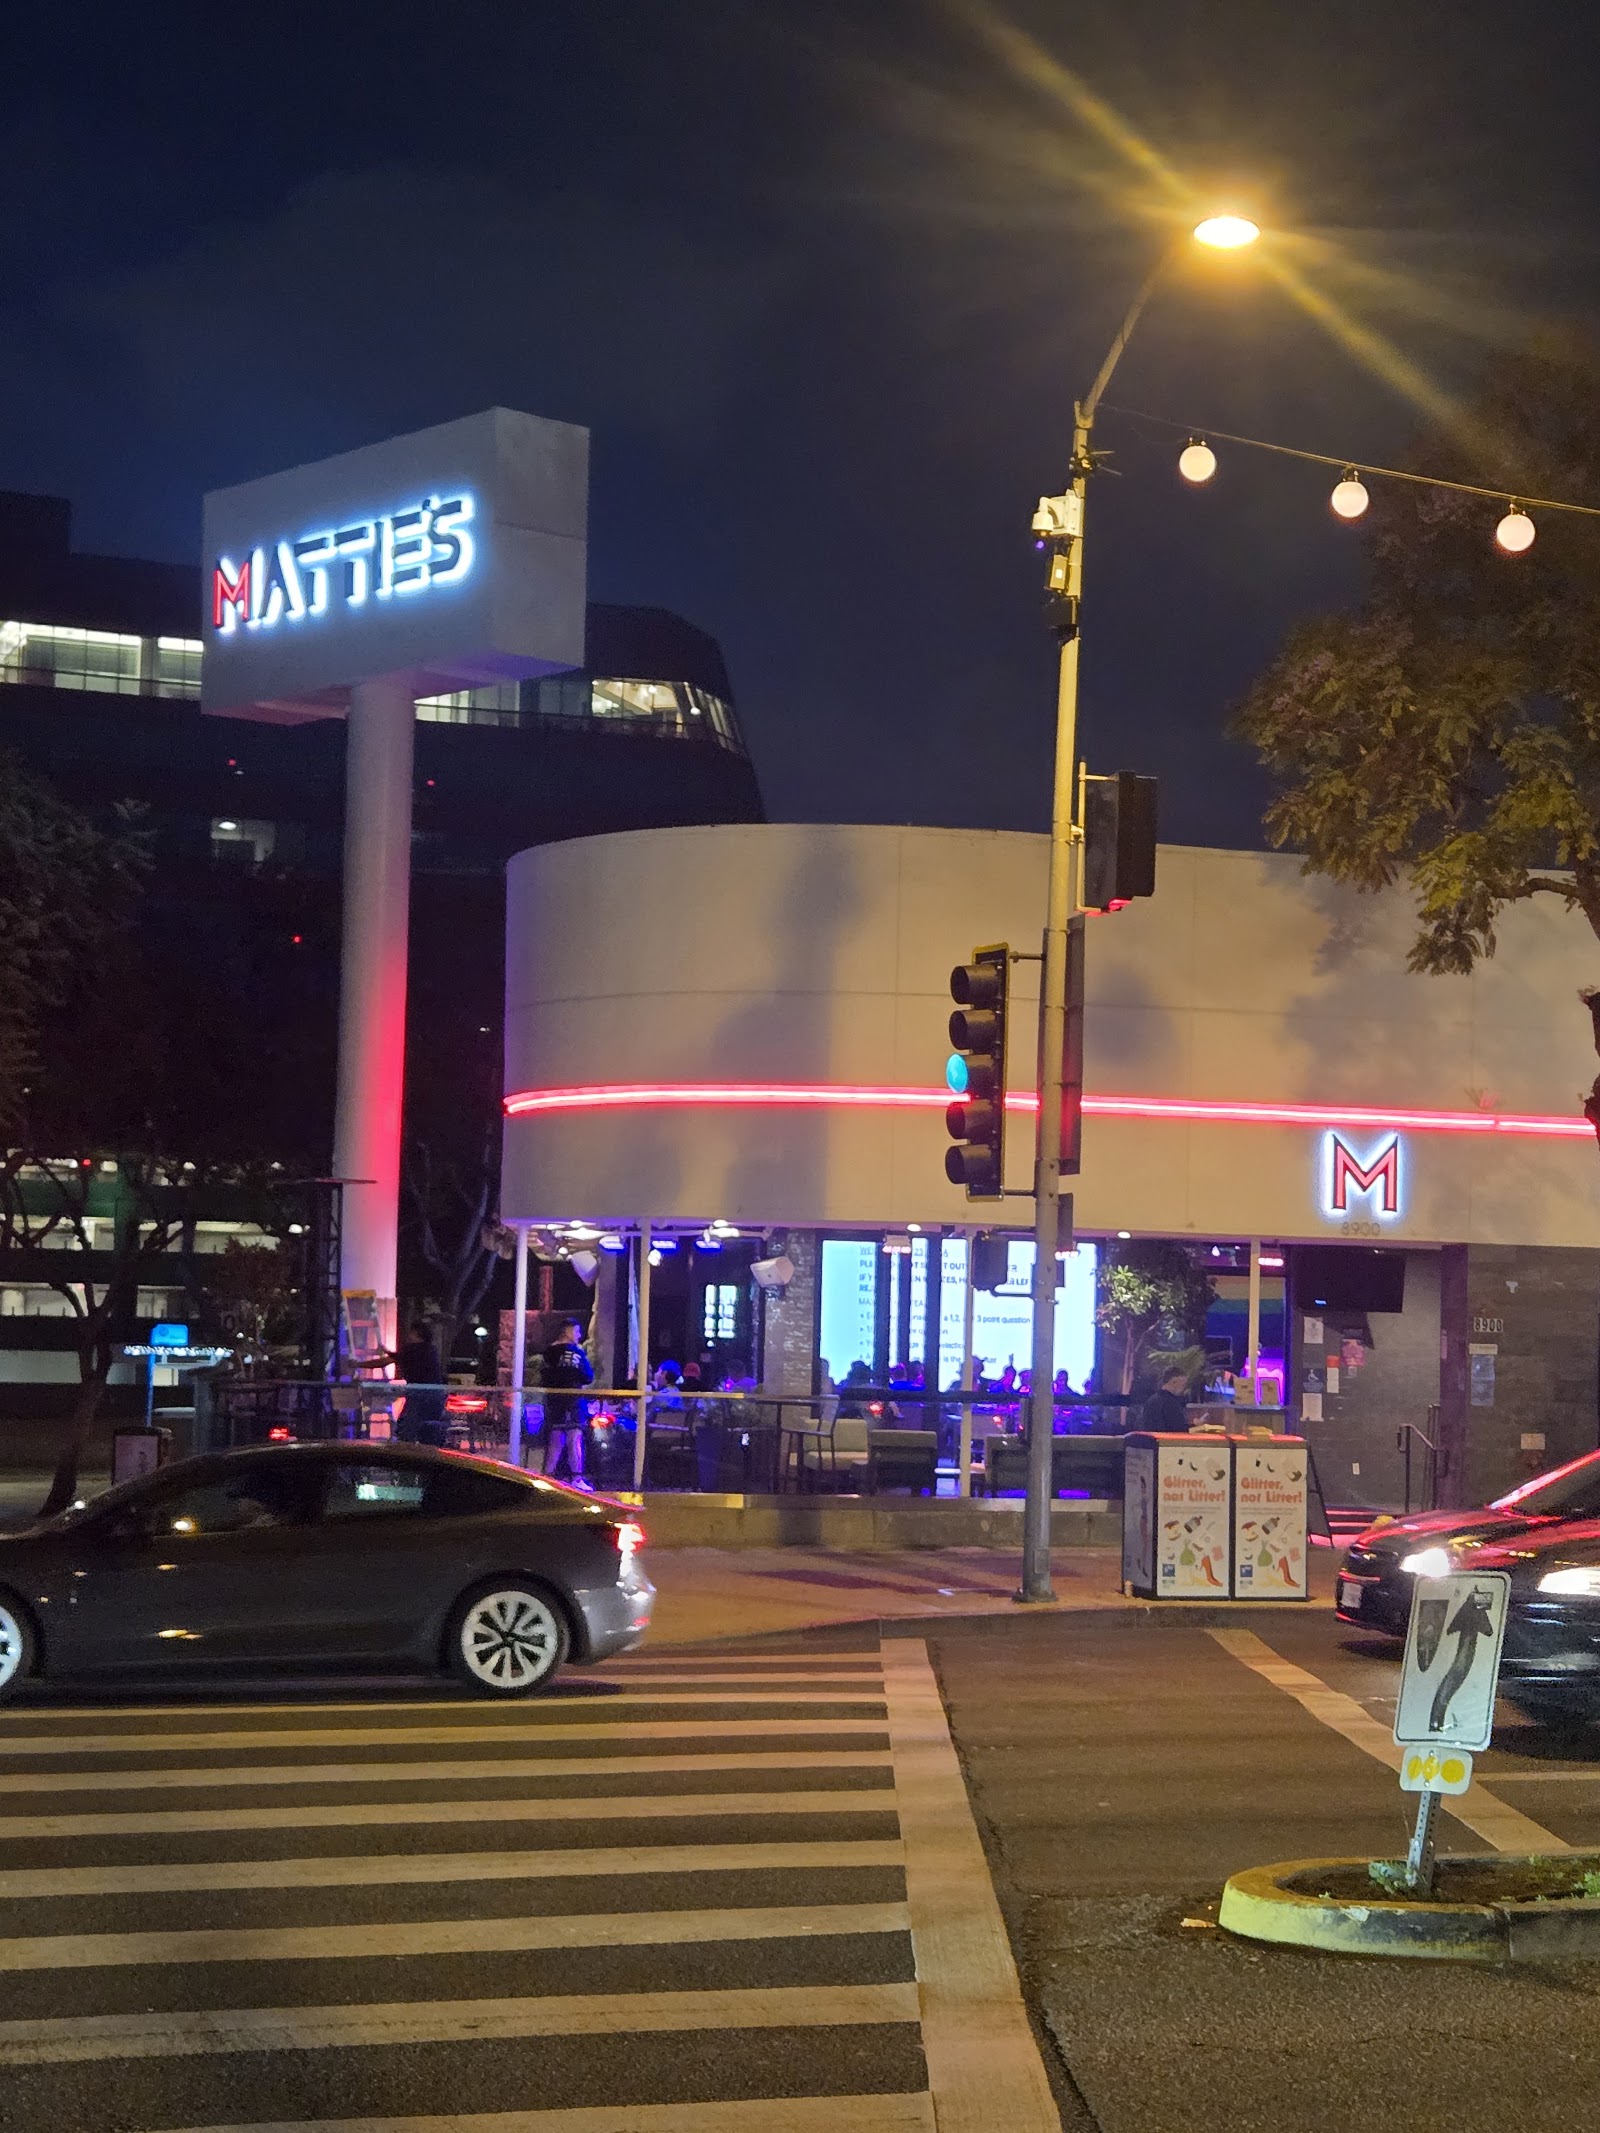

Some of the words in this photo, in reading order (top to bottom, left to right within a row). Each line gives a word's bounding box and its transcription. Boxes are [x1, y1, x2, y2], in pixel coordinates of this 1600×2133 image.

[211, 495, 475, 634] MATTE'S
[1328, 1132, 1400, 1214] M
[1341, 1221, 1381, 1237] 8900
[1474, 1318, 1503, 1332] 8900
[1163, 1491, 1184, 1501] not
[1188, 1489, 1226, 1502] Litter!
[1241, 1492, 1261, 1503] not
[1266, 1491, 1302, 1504] Litter!
